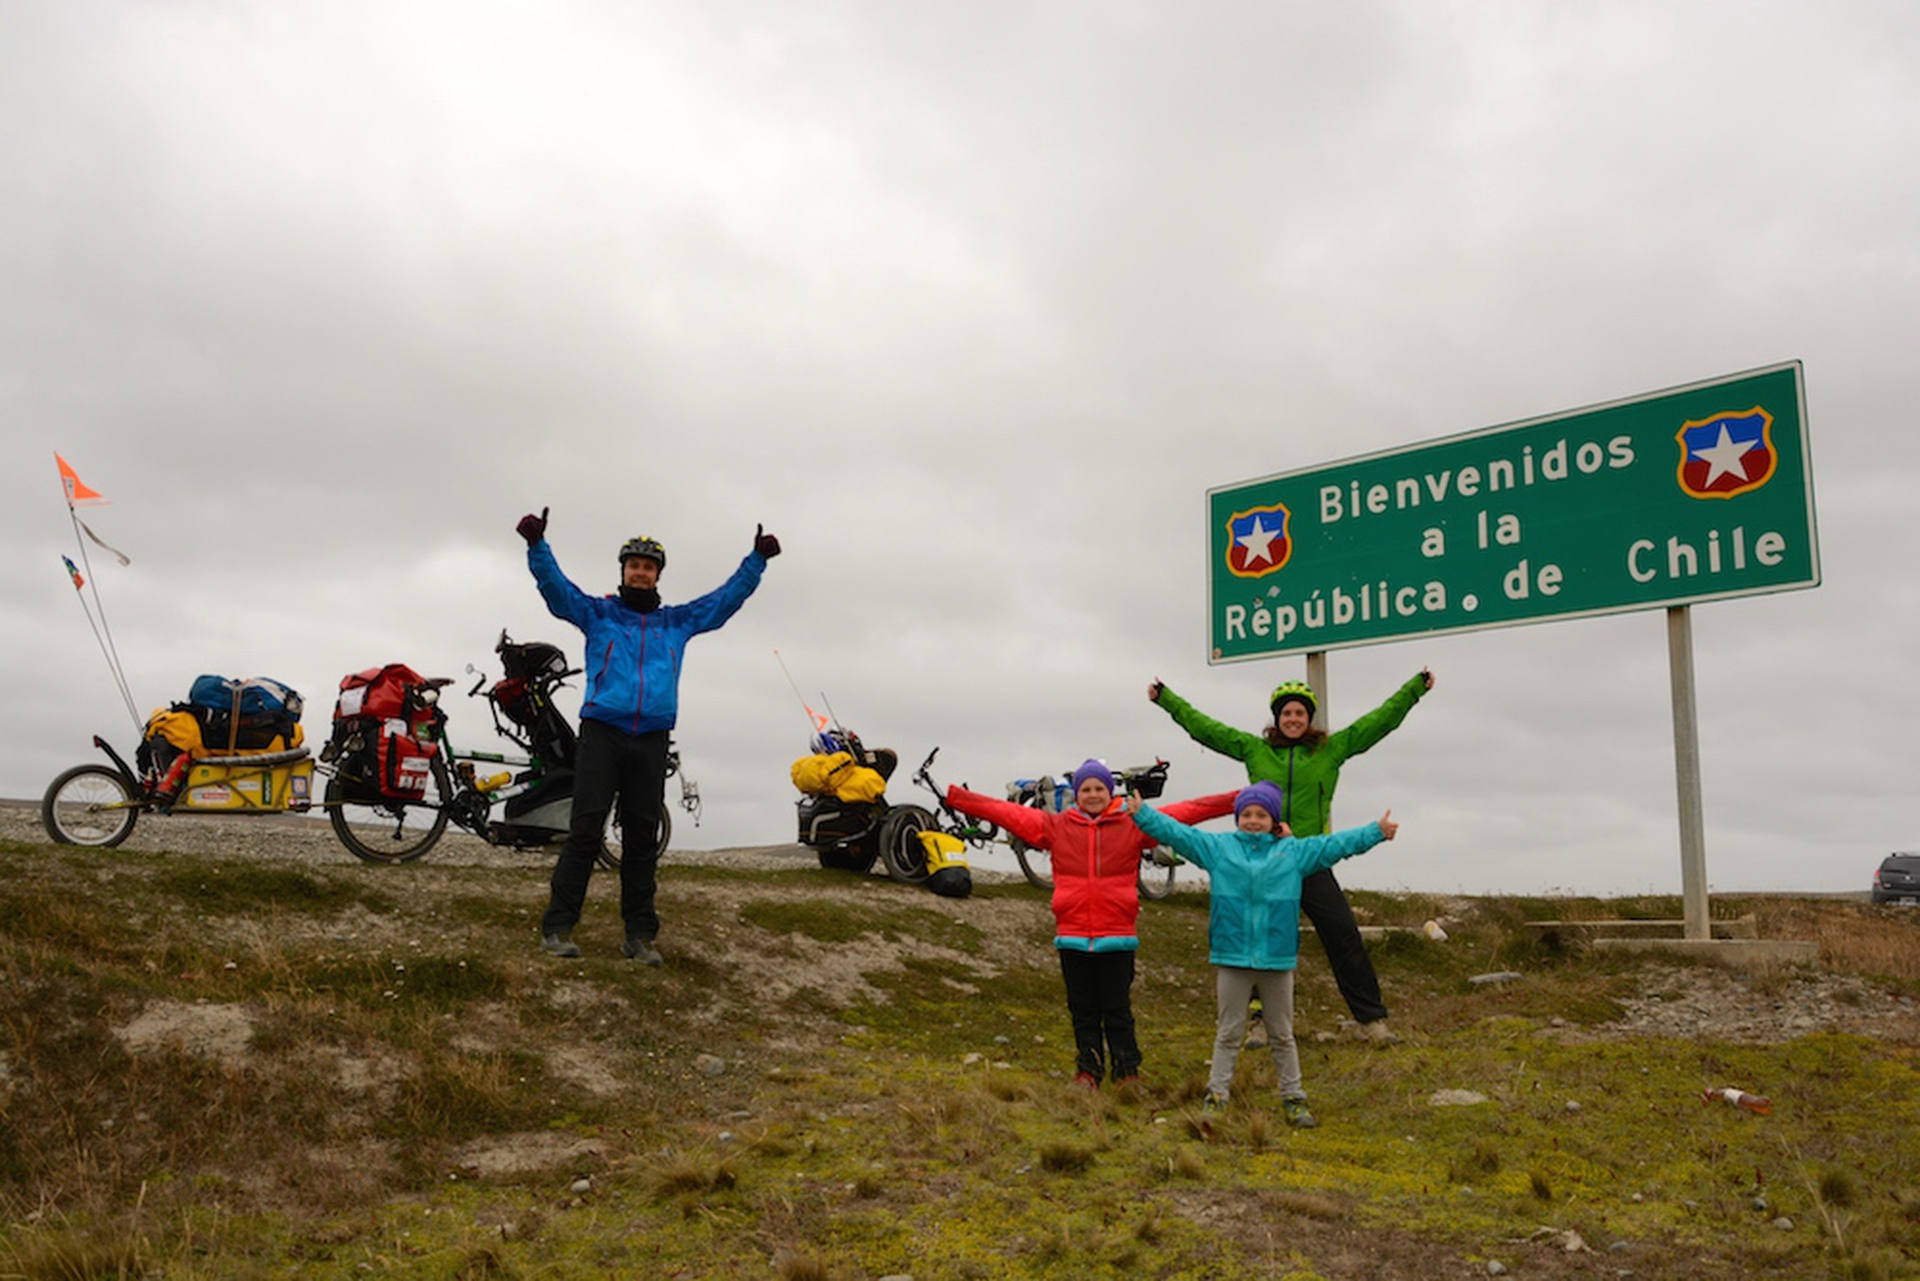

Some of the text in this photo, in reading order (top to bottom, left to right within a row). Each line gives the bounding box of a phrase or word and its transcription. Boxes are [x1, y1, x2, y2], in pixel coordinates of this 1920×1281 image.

[1320, 436, 1634, 523] Bienvenidos
[1421, 510, 1520, 557] a la
[1504, 559, 1563, 599] de
[1628, 527, 1786, 582] Chile
